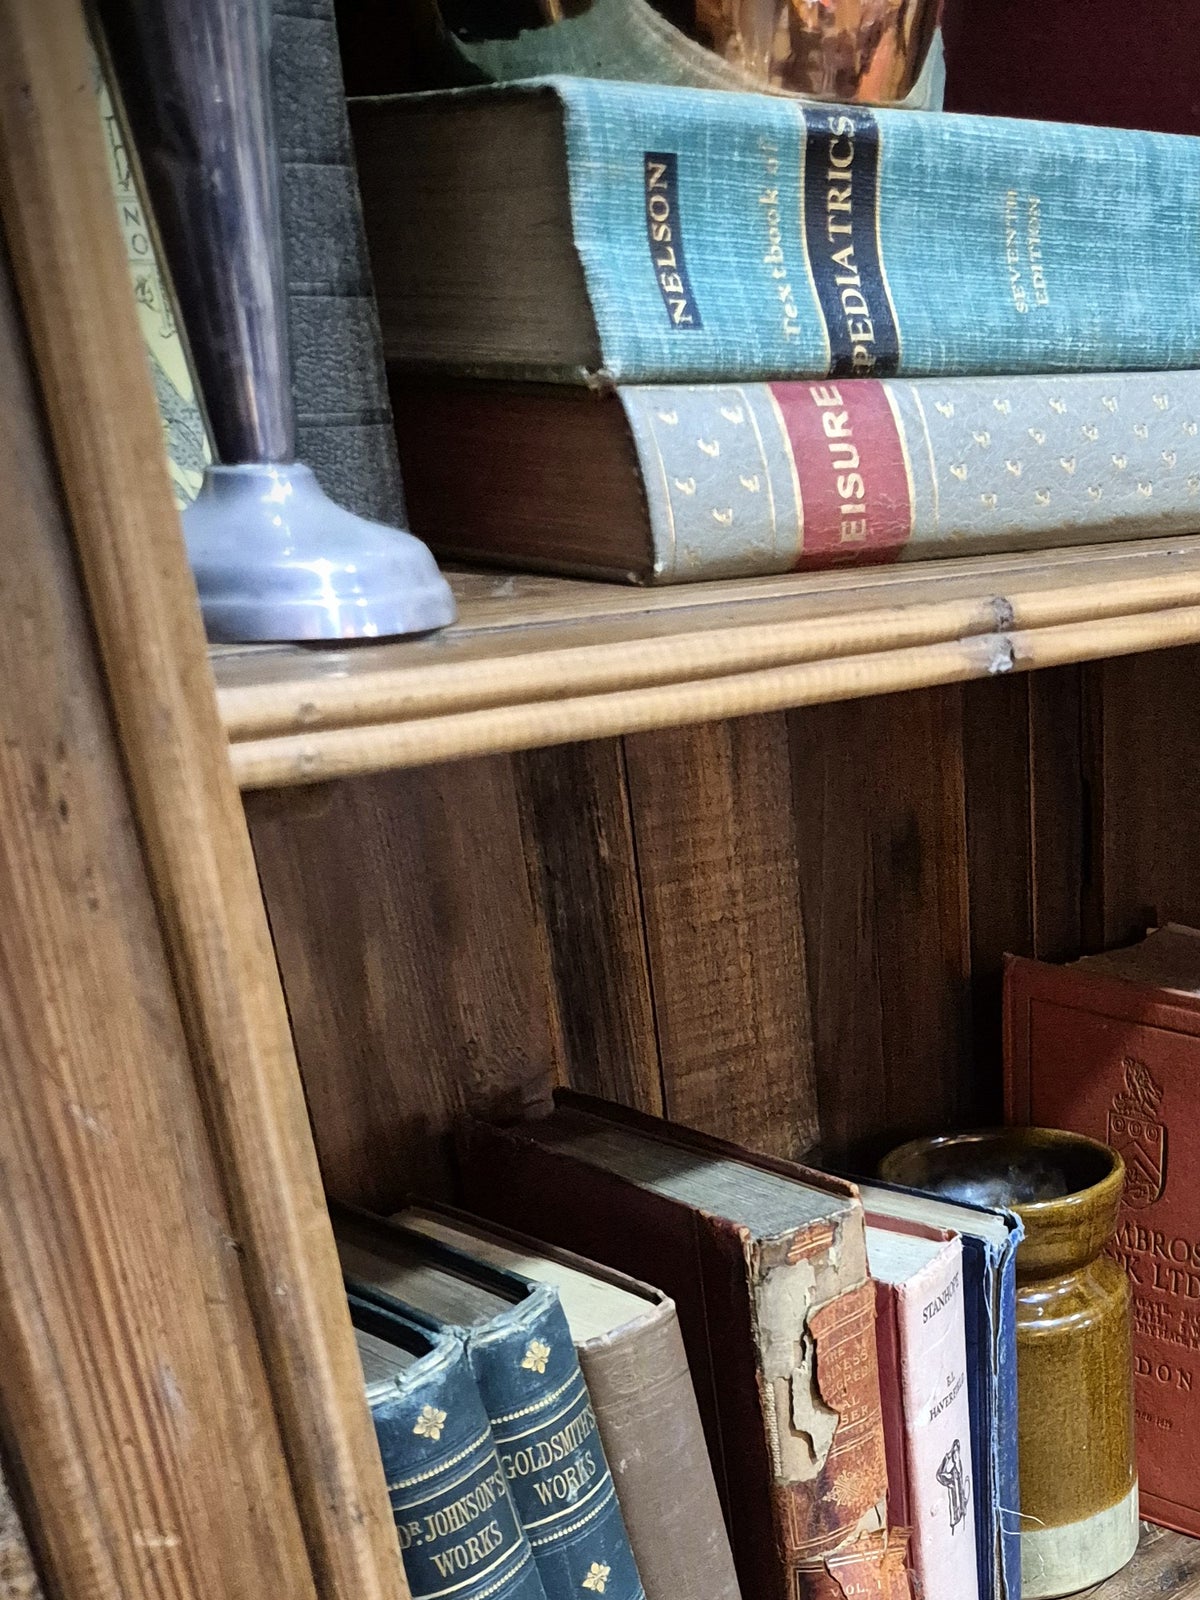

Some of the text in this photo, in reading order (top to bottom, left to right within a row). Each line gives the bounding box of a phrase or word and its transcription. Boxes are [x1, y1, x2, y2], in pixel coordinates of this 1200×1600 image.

[647, 161, 694, 325] NELSON
[758, 188, 801, 342] Textbook
[827, 115, 877, 375] PEDIATRICS
[1004, 190, 1029, 314] SEVENTH
[1026, 196, 1049, 306] EDITION
[809, 385, 867, 543] EISURE
[826, 1348, 845, 1364] THE
[1134, 1355, 1193, 1391] DON
[423, 1470, 506, 1542] JOHNSON'S
[533, 1449, 597, 1506] WORKS
[429, 1519, 504, 1578] WORKS
